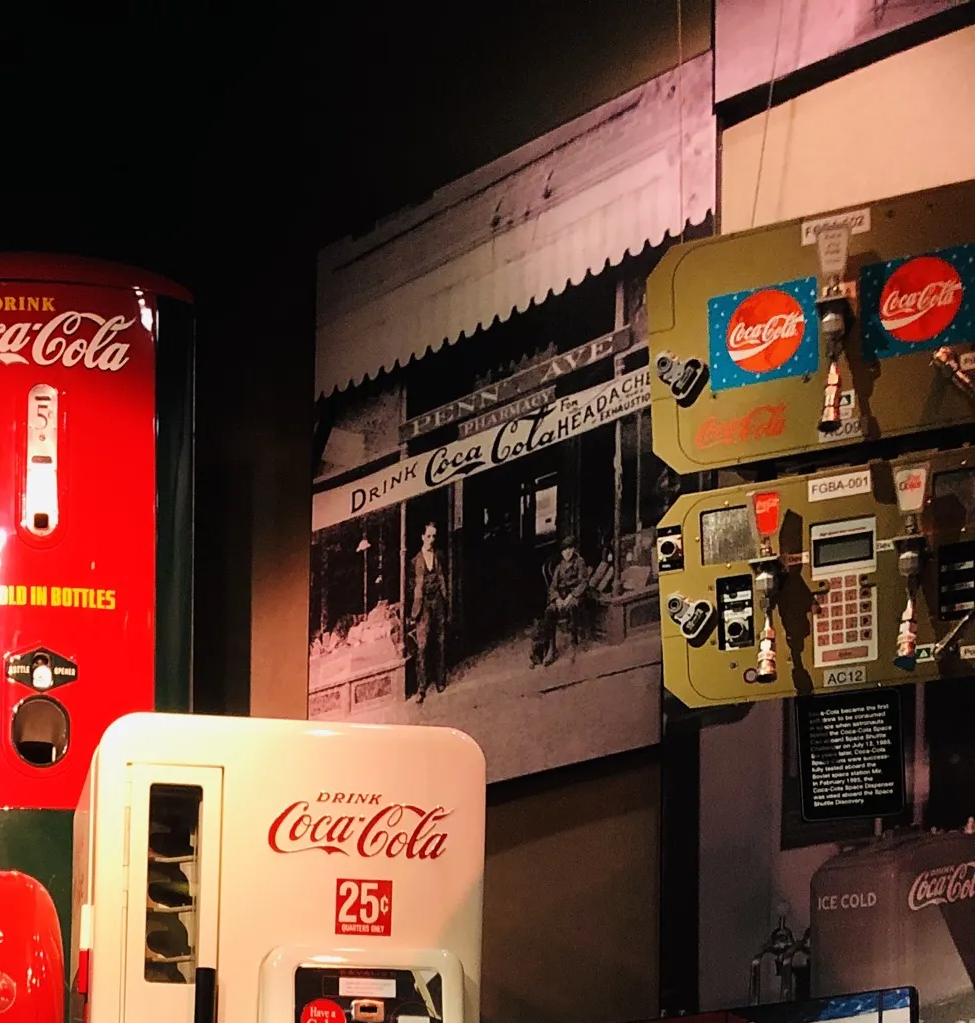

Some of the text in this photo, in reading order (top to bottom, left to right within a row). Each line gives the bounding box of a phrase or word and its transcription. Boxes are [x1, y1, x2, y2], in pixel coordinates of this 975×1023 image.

[882, 280, 963, 317] Coca-Cola
[728, 312, 805, 348] Coca-Cola
[540, 335, 614, 384] AVE
[463, 389, 554, 438] PHARMACY
[557, 372, 651, 440] HEADACHE
[350, 403, 559, 514] DRINK Coca Cola
[811, 475, 869, 495] FGBA-001
[30, 586, 47, 606] IN
[51, 587, 116, 610] BOTTLES
[827, 670, 863, 685] AC12
[316, 791, 383, 806] DRINK
[267, 800, 456, 861] Coca-Cola
[337, 880, 390, 925] 25¢
[817, 891, 877, 911] ICE COLD
[341, 923, 385, 934] QUARTERS ONLY
[310, 1006, 337, 1019] Have a
